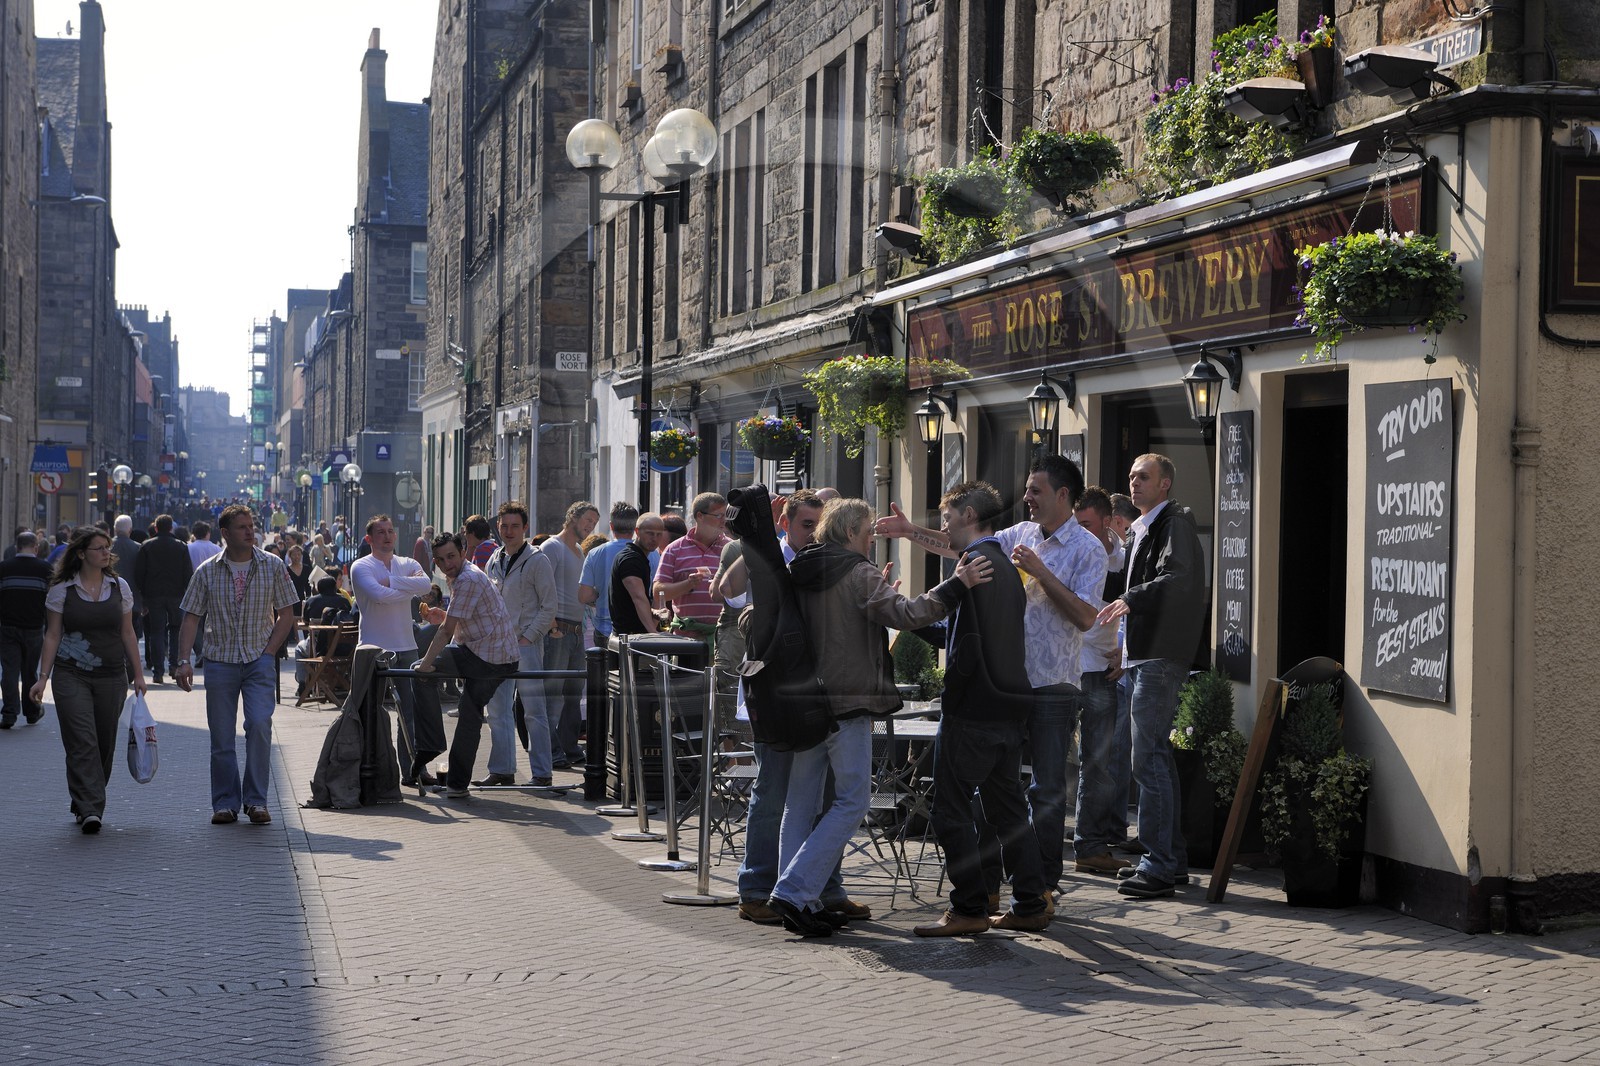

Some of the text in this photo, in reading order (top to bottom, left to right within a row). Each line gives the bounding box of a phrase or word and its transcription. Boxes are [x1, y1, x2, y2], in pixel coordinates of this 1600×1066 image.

[1432, 28, 1476, 63] STREET
[971, 319, 992, 349] THE
[1004, 290, 1063, 355] ROSE
[1118, 239, 1269, 334] BREWERY
[560, 353, 582, 362] ROSE
[1228, 425, 1242, 443] FREE
[1377, 386, 1443, 453] TRY OUR
[33, 461, 68, 469] SKIPTON
[1376, 480, 1446, 518] UPSTAIRS
[1222, 537, 1248, 558] FAIRTRADE
[1225, 568, 1245, 590] COFFEE
[1371, 556, 1447, 599] RESTAURANT
[1225, 599, 1242, 622] MENU
[1372, 597, 1399, 628] for the
[1375, 602, 1446, 668] BEST STEAKS
[1410, 648, 1448, 693] around!
